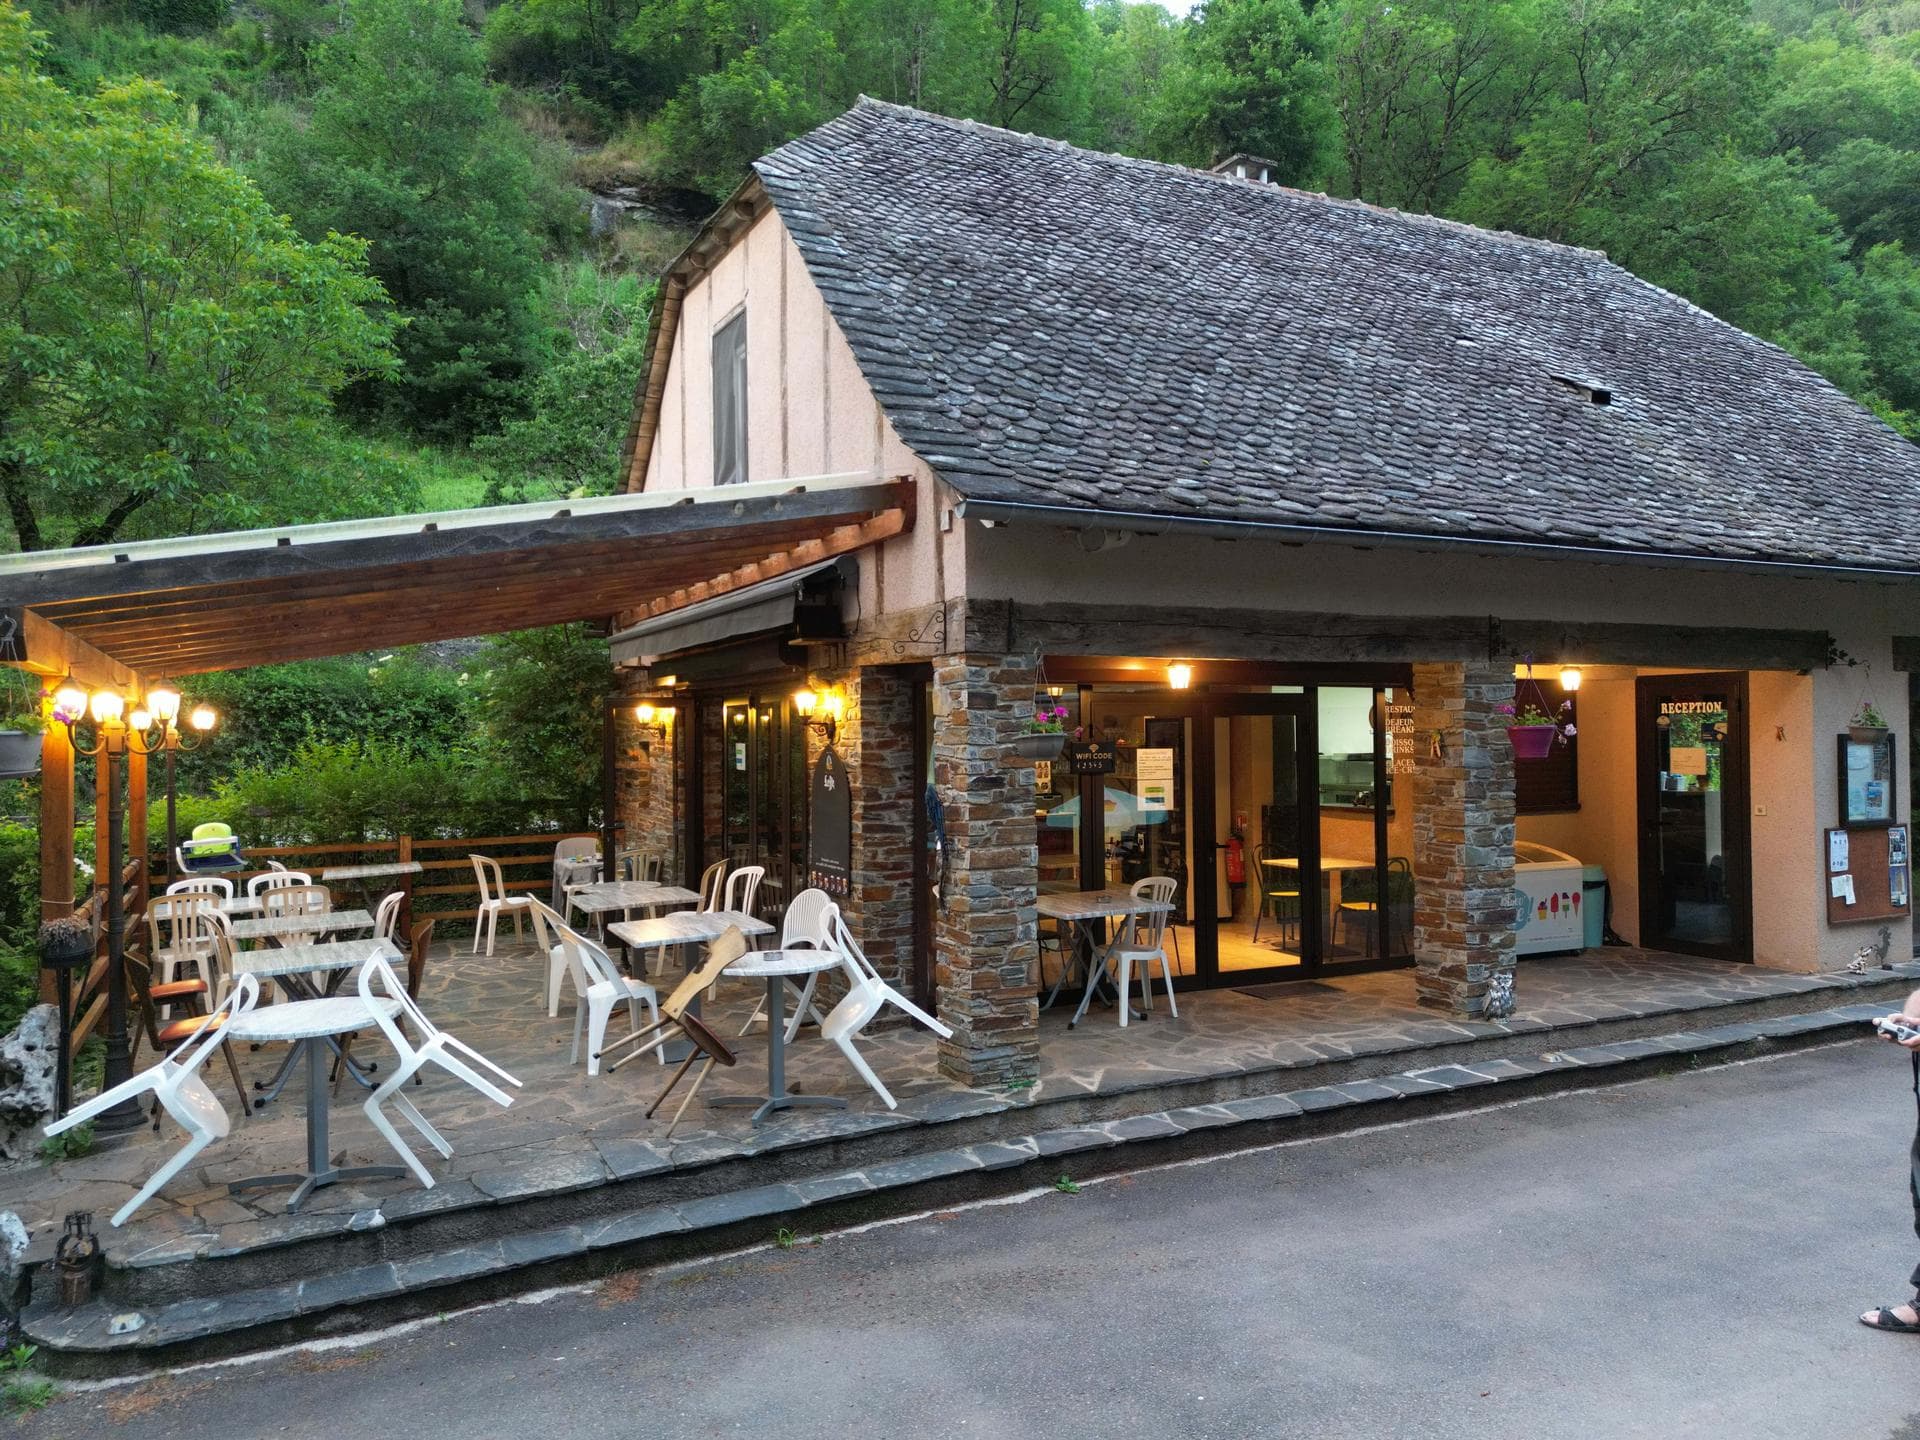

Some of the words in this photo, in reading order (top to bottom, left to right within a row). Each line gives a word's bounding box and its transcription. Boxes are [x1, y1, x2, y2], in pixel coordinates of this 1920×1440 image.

[1661, 701, 1722, 714] RECEPTION
[1387, 746, 1415, 754] RINKS
[1093, 752, 1113, 760] CODE
[1386, 766, 1415, 774] ICE-CR
